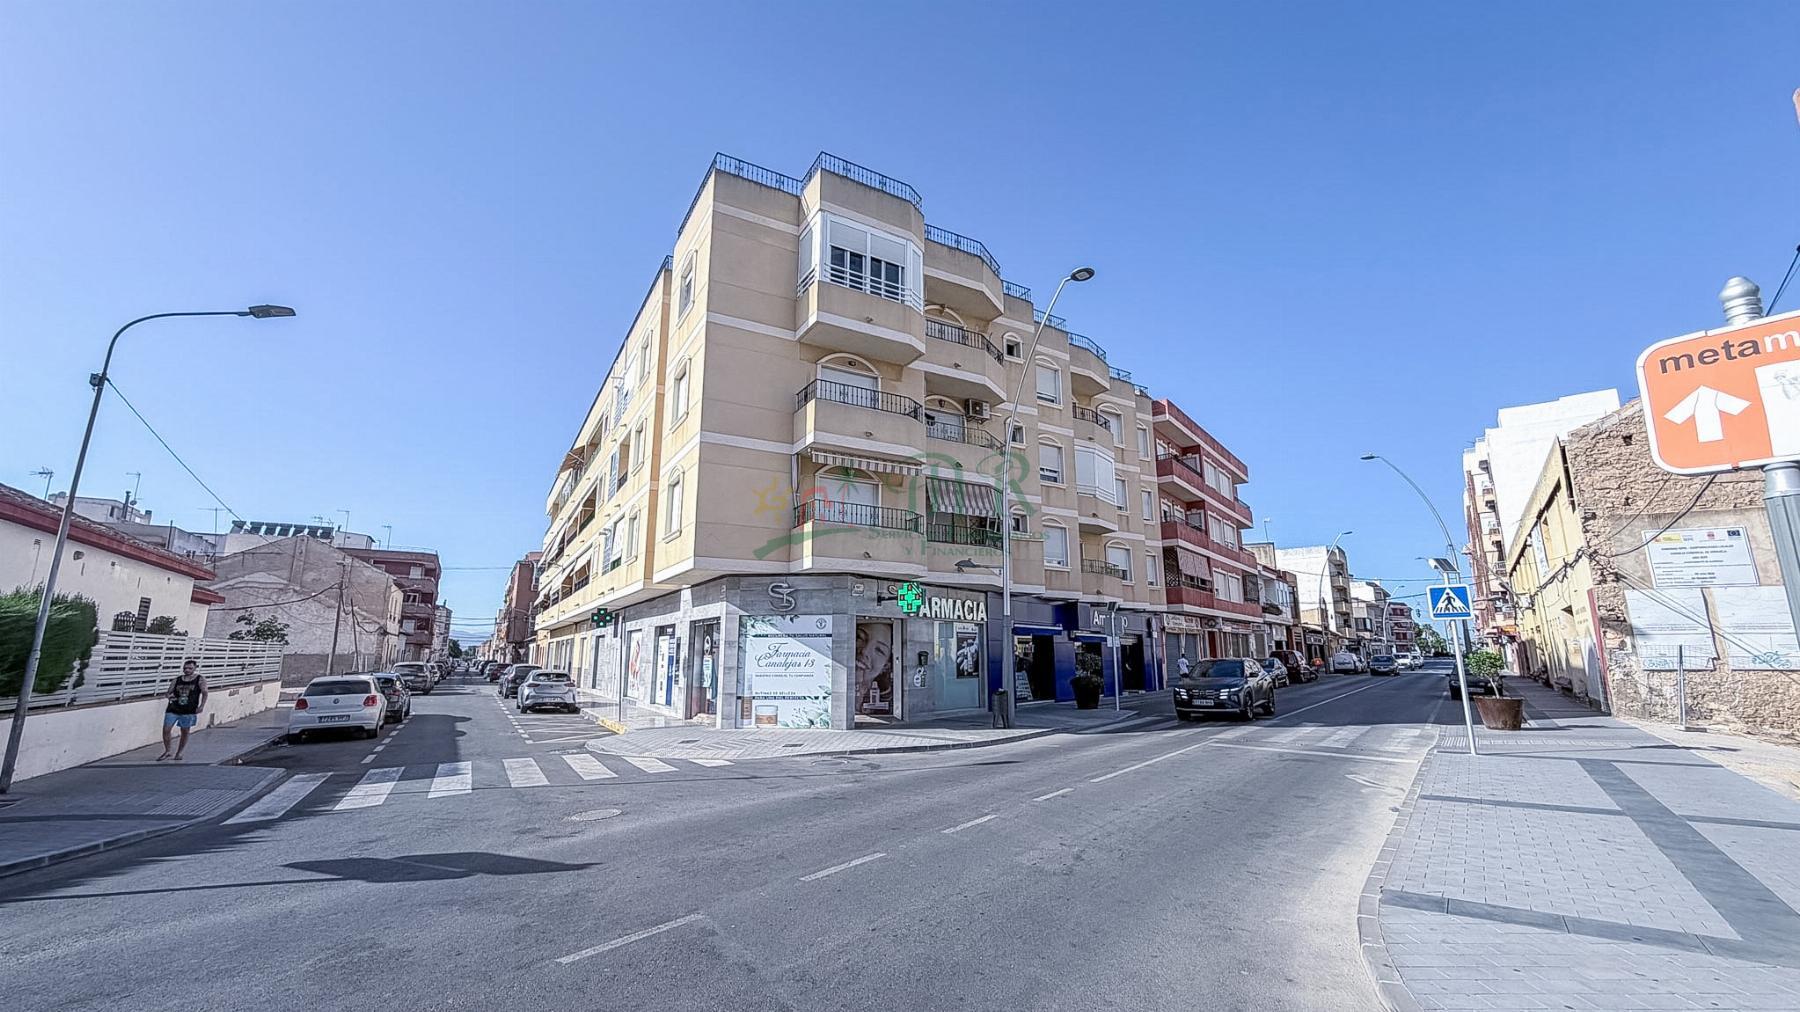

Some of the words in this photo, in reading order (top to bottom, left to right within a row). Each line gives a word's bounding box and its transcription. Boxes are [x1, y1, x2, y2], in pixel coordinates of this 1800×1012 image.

[911, 597, 987, 621] ARMACIA
[768, 642, 811, 660] Farmacia
[755, 653, 801, 671] Canalejas
